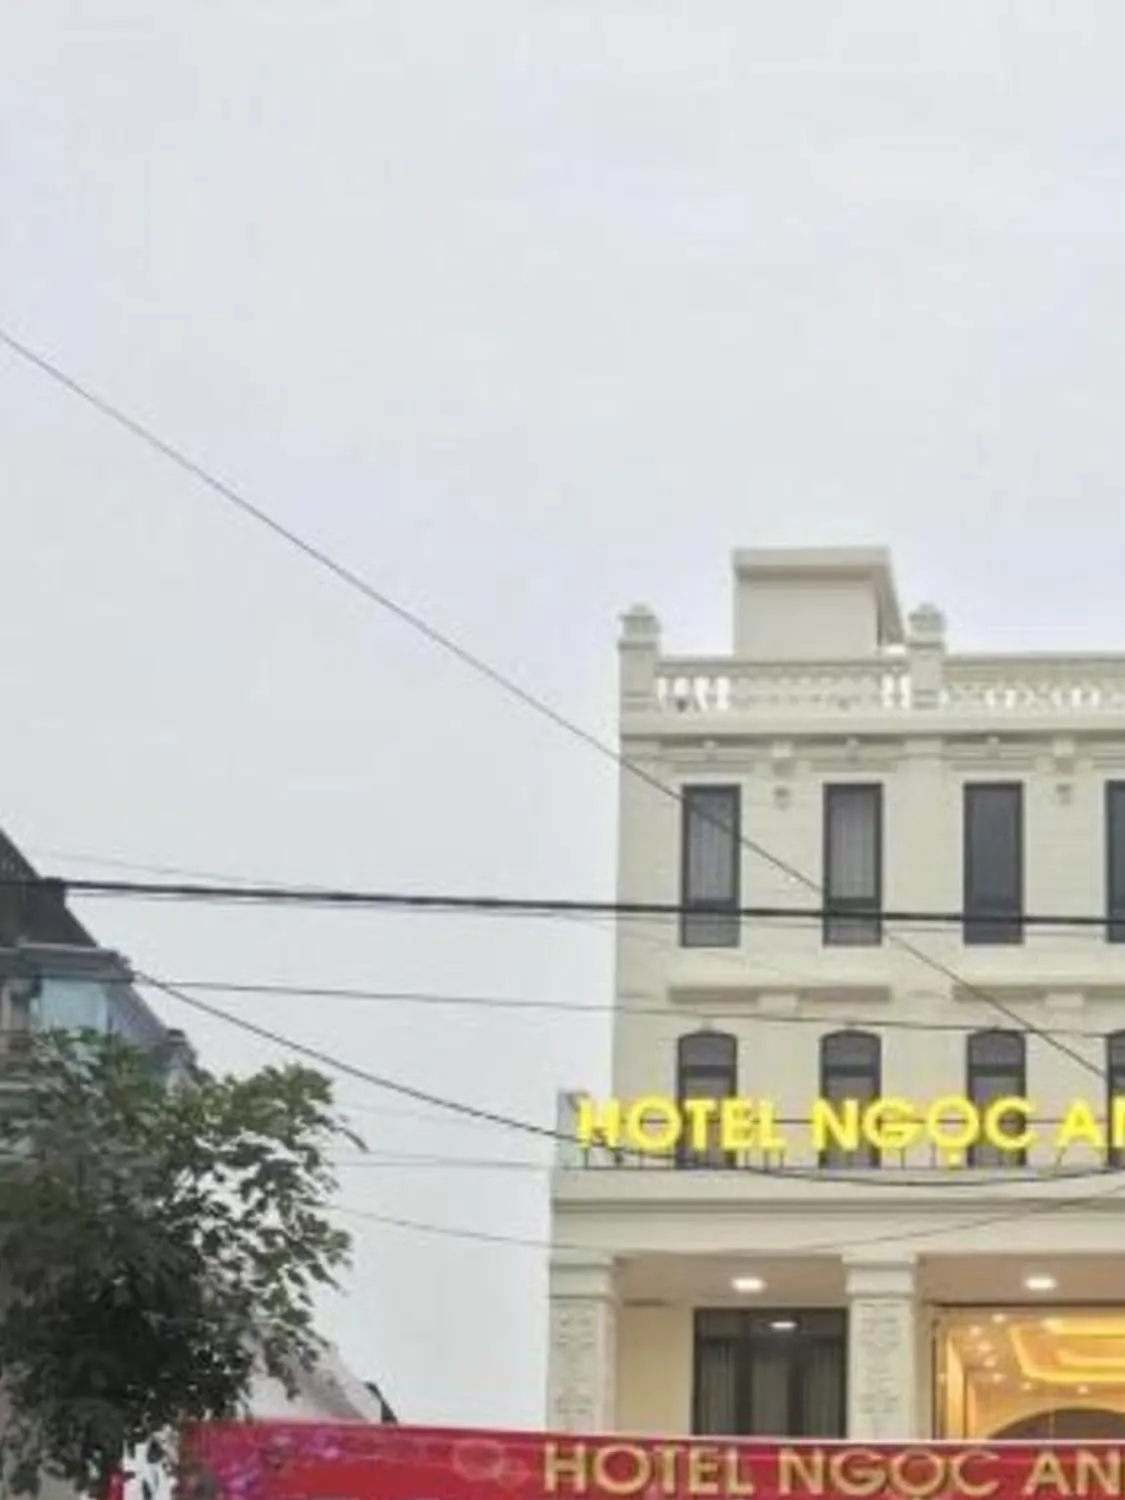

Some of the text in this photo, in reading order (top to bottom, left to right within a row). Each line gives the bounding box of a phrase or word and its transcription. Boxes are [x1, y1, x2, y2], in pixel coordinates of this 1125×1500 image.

[575, 1097, 787, 1150] HOTEL
[812, 1095, 1037, 1167] NGỌC
[543, 1445, 756, 1497] HOTEL
